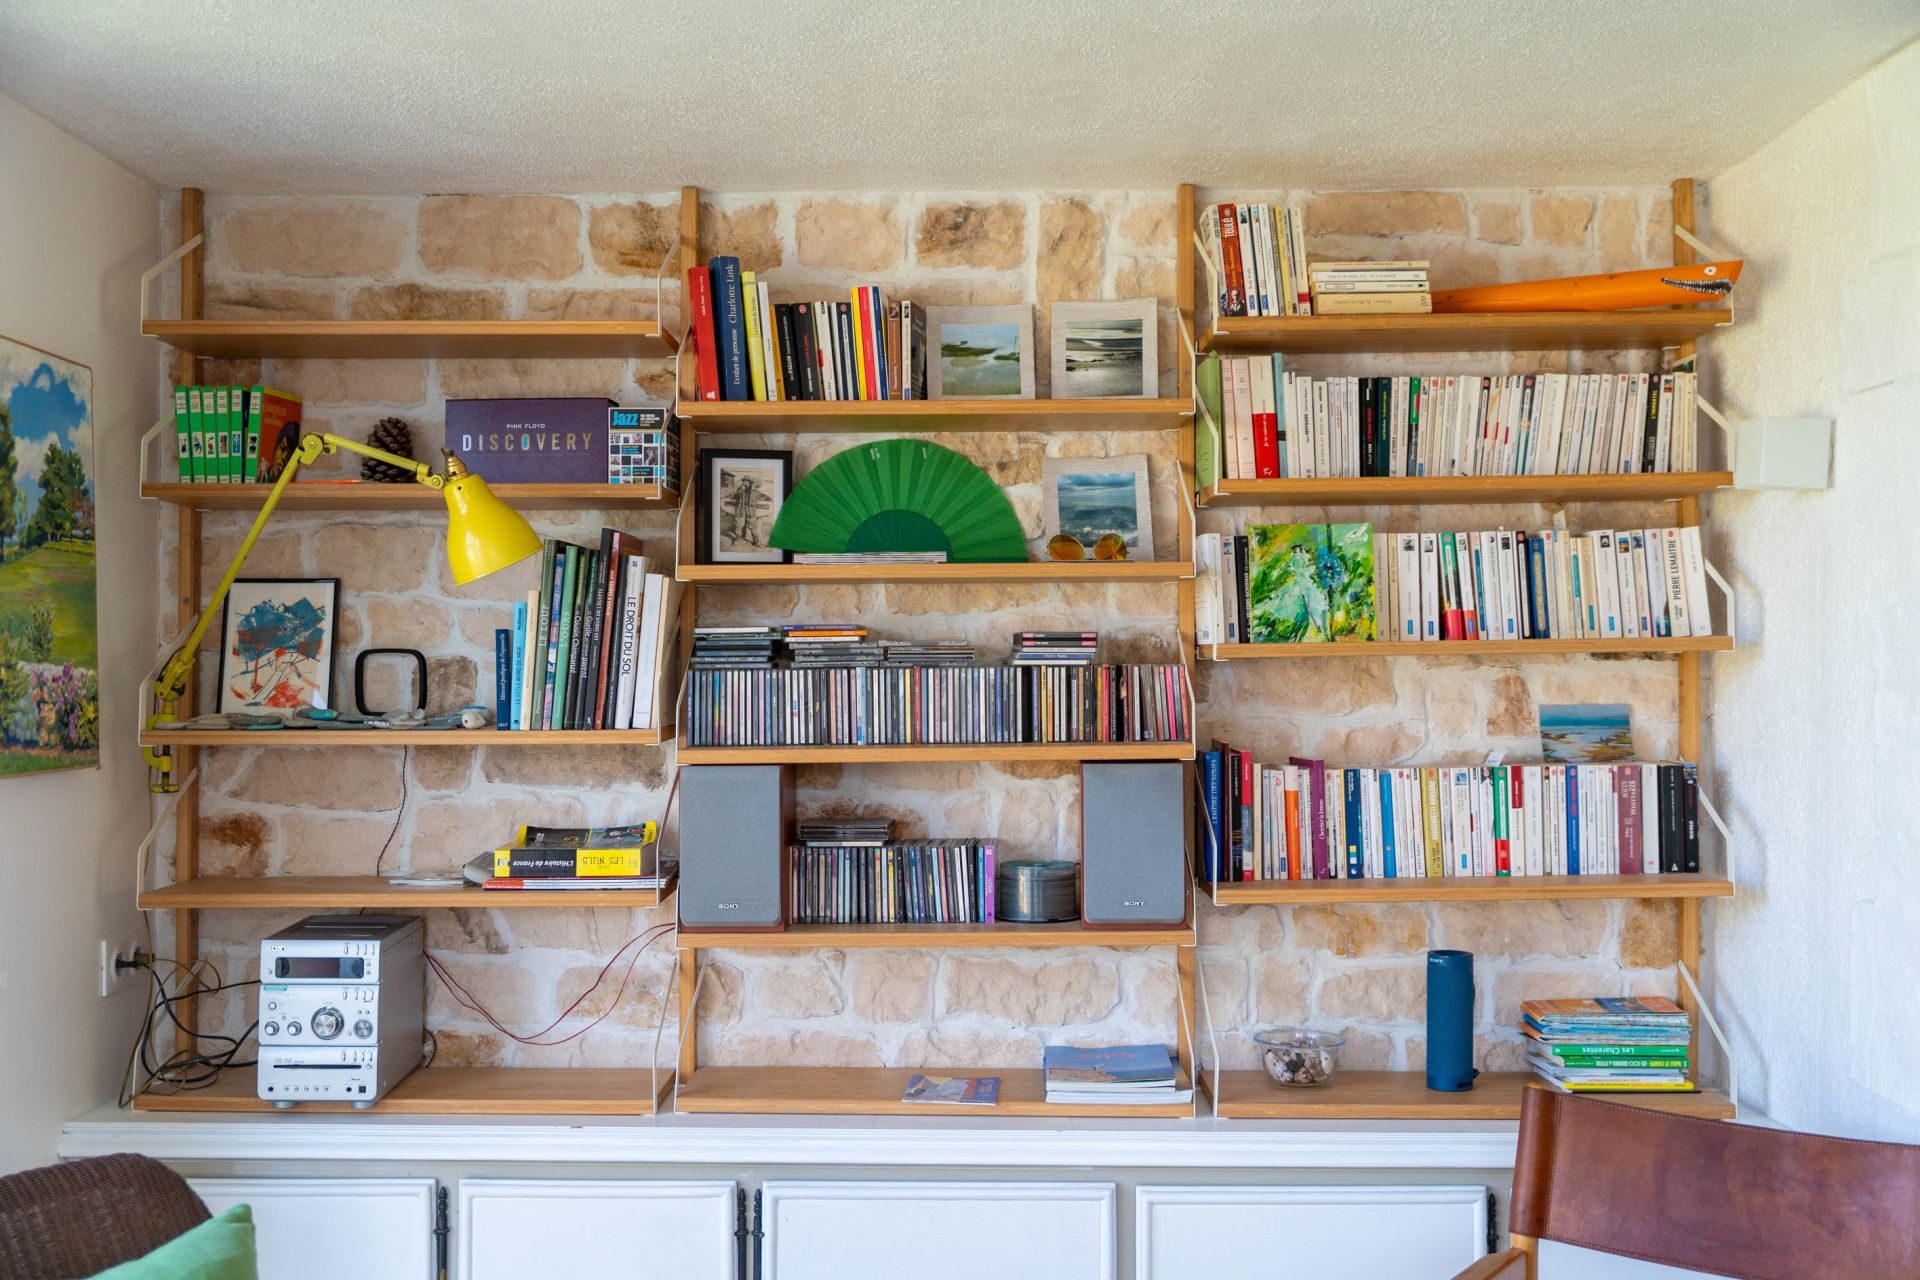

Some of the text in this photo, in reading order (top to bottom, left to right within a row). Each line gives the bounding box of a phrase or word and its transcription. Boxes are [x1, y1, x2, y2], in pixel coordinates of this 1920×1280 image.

[726, 264, 738, 324] Charlotte Link
[732, 328, 740, 354] personne
[732, 363, 740, 384] L'enfant
[613, 411, 638, 425] Jazz
[462, 432, 592, 452] DISCOVERY
[1668, 539, 1682, 600] PIERRE LEMAITRE
[539, 604, 548, 647] LE LOUP
[561, 611, 570, 647] L'OURS
[573, 616, 581, 637] Cousin
[584, 616, 593, 637] Gorille
[621, 596, 636, 677] LE DROIT DU SOL
[516, 659, 522, 668] DE
[569, 639, 579, 674] Chimpanzé
[581, 657, 589, 679] parent
[608, 857, 624, 865] LES
